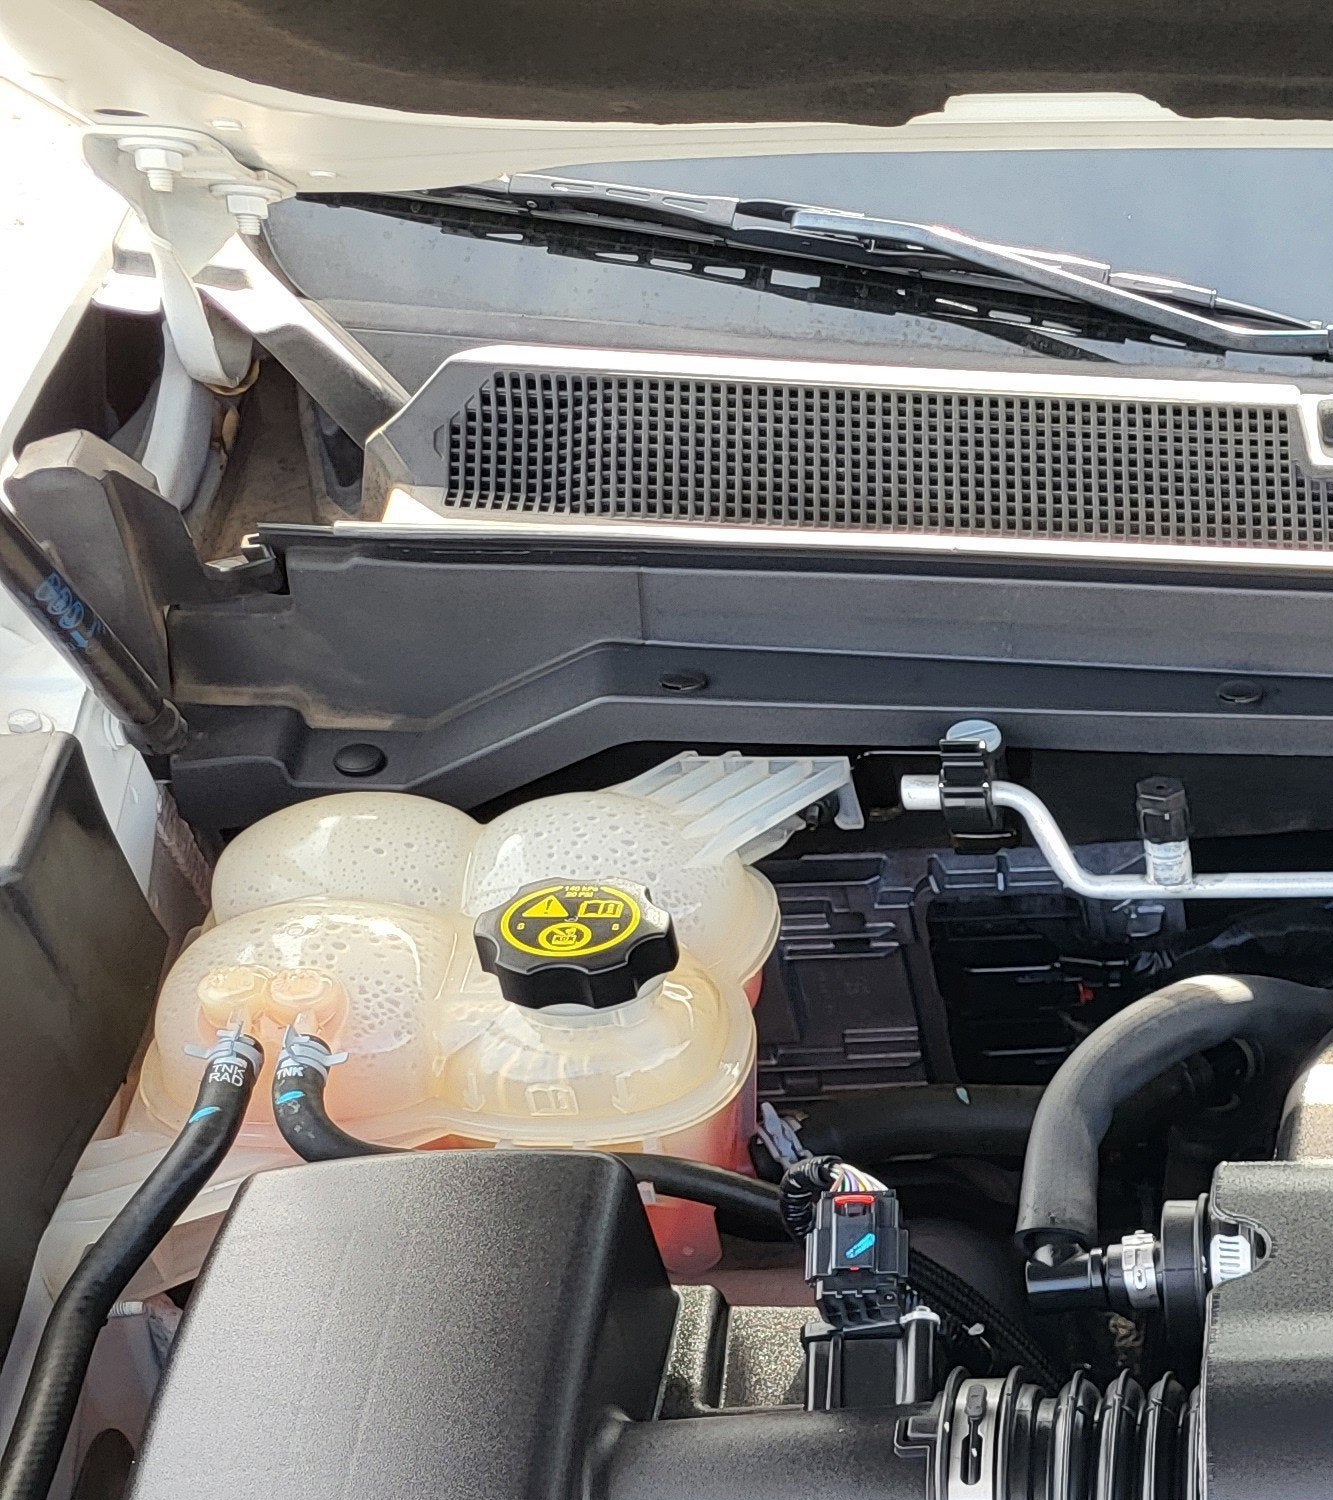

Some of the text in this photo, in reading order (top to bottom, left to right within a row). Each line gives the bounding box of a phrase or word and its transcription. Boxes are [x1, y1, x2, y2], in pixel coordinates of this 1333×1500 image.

[212, 1063, 246, 1079] TNK
[276, 1066, 305, 1080] TNK
[208, 1072, 244, 1087] RAD
